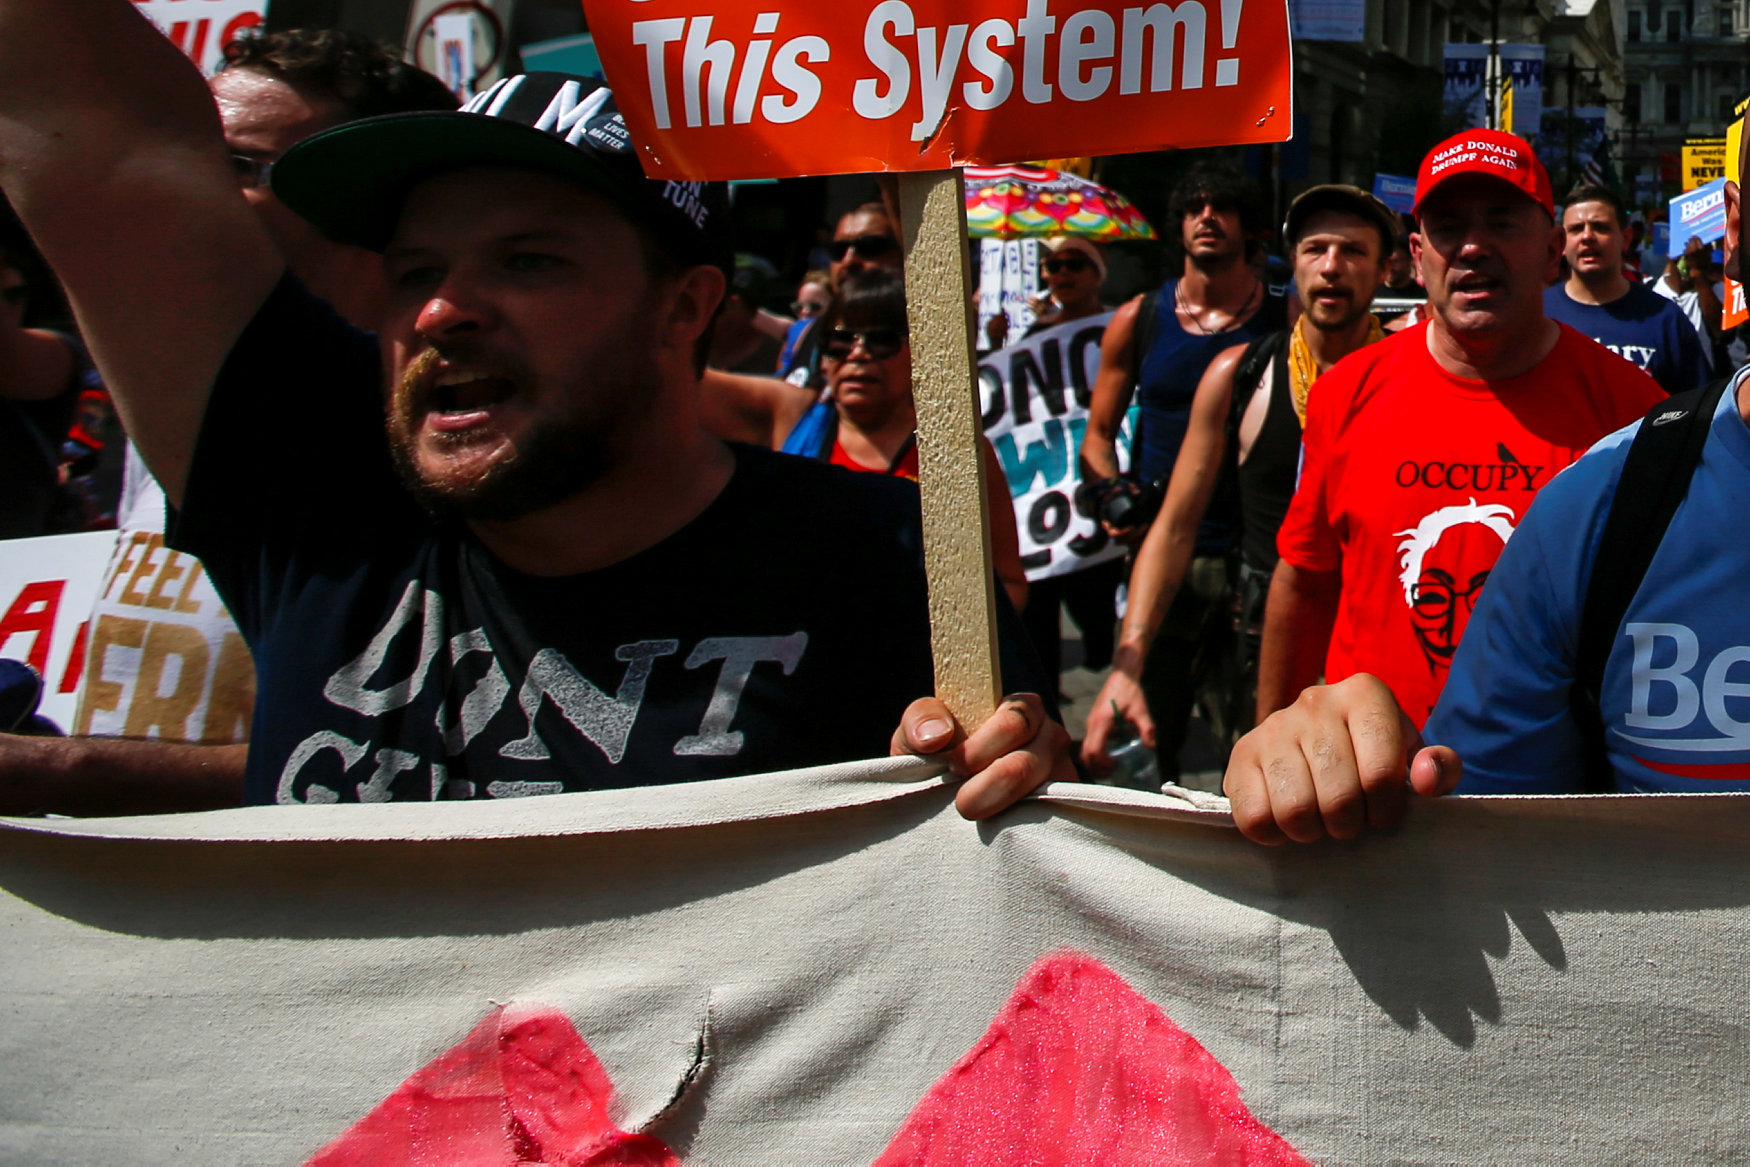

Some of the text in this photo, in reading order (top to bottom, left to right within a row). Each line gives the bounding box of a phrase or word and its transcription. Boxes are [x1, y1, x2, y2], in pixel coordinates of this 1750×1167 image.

[632, 12, 831, 130] This
[588, 127, 625, 151] MATTER
[603, 122, 630, 140] LIVES
[1431, 152, 1518, 175] DRUMPF AGAIN
[1432, 140, 1518, 164] MAKE DONALD
[1395, 460, 1545, 492] OCCUPY
[102, 530, 204, 614] FEEL
